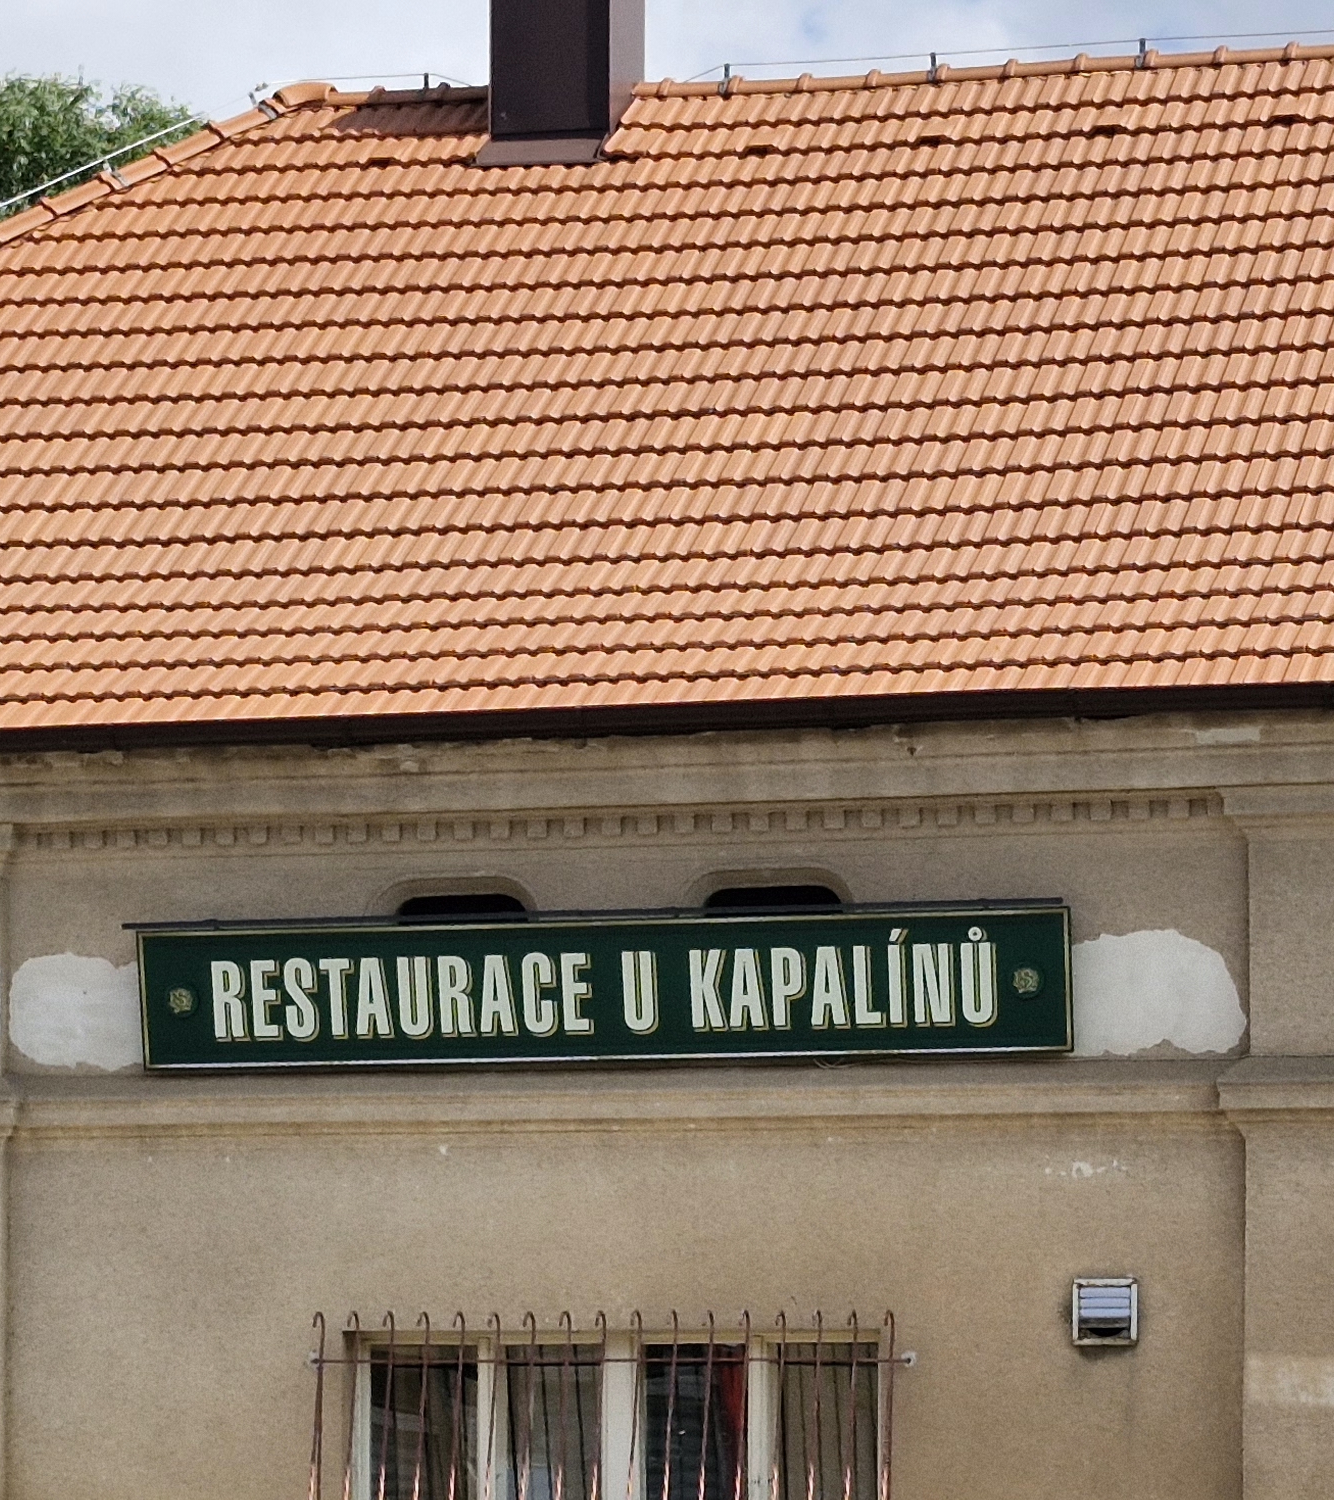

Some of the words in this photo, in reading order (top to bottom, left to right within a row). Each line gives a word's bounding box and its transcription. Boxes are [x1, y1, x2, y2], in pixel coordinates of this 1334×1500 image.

[211, 951, 594, 1042] RESTAURACE
[621, 950, 658, 1035] U
[689, 926, 997, 1032] KAPALÍNŮ
